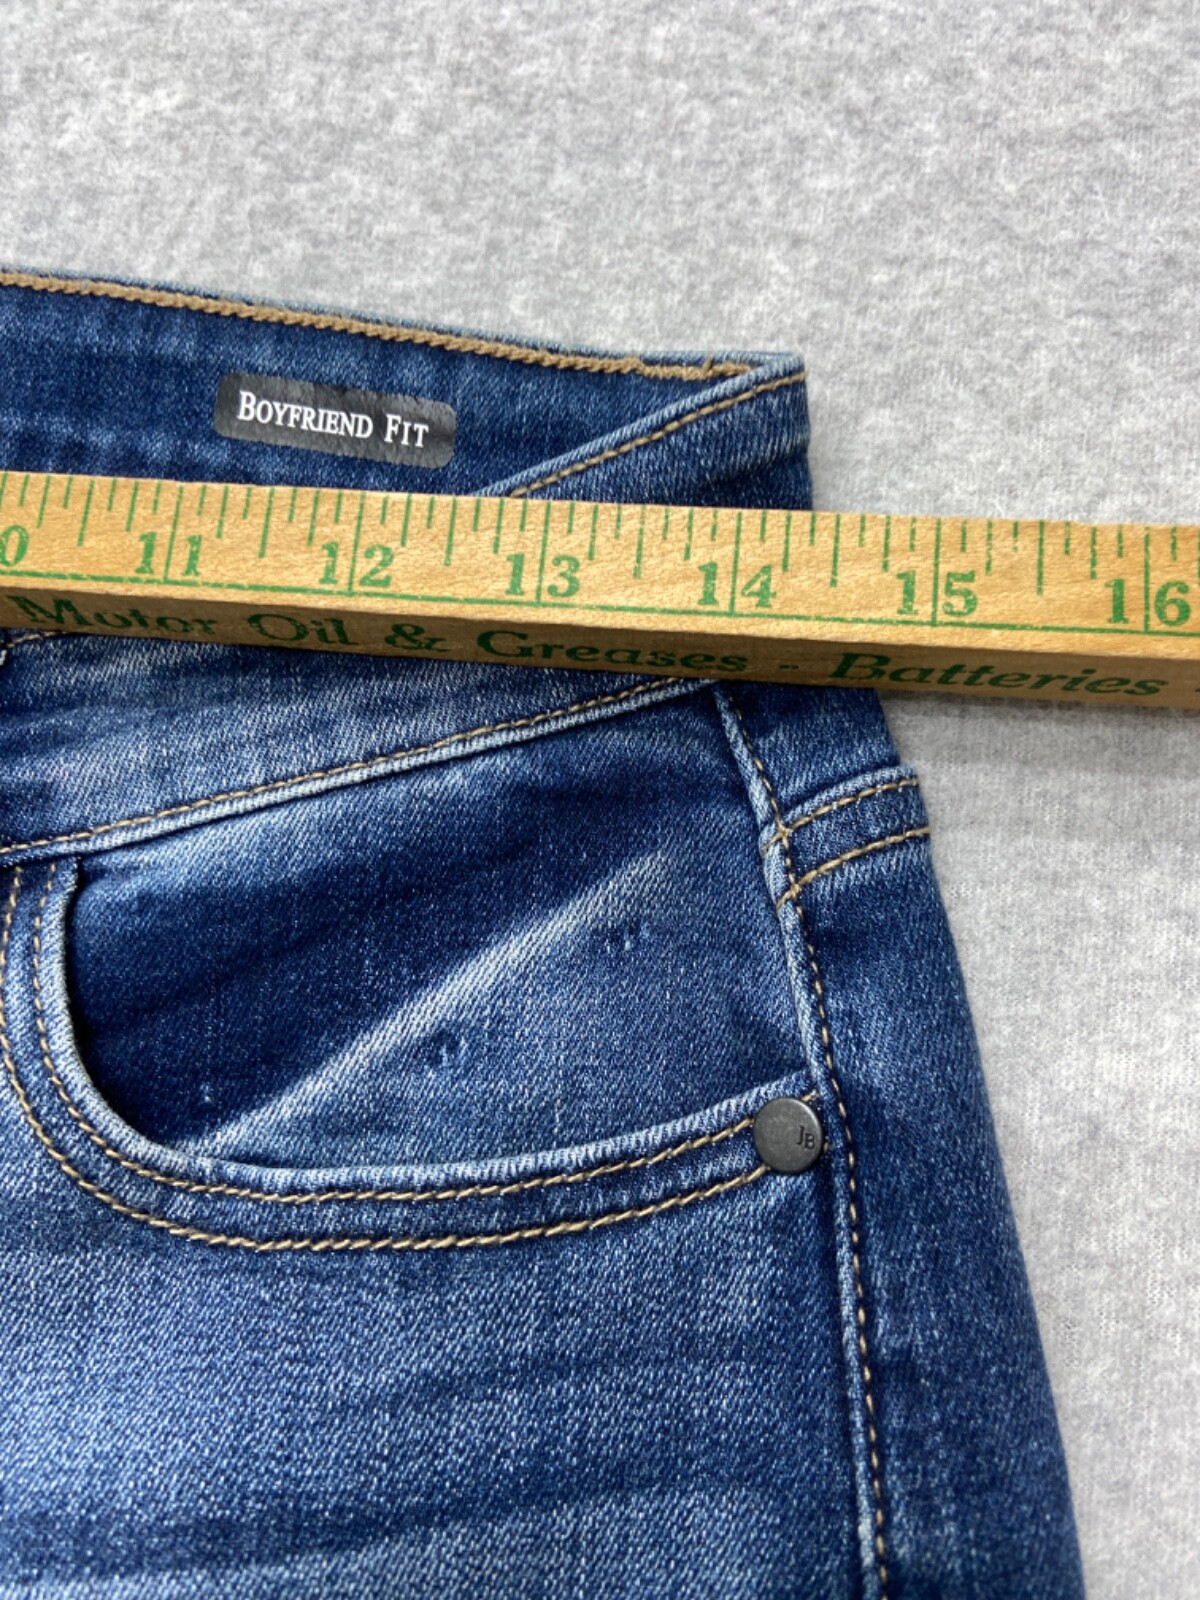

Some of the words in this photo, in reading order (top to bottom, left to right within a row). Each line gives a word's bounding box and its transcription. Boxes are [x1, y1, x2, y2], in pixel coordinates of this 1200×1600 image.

[237, 390, 374, 439] BOYFRIEND
[384, 413, 430, 448] FIT
[134, 532, 203, 577] 11
[319, 541, 395, 588] 12
[505, 552, 582, 598] 13
[696, 561, 777, 609] 14
[895, 570, 979, 618] 15
[1104, 578, 1192, 627] 16
[6, 595, 219, 636] Motor
[247, 613, 359, 646] Oil
[383, 623, 452, 653] &
[476, 630, 749, 672] Greases
[828, 652, 1170, 697] Batteries
